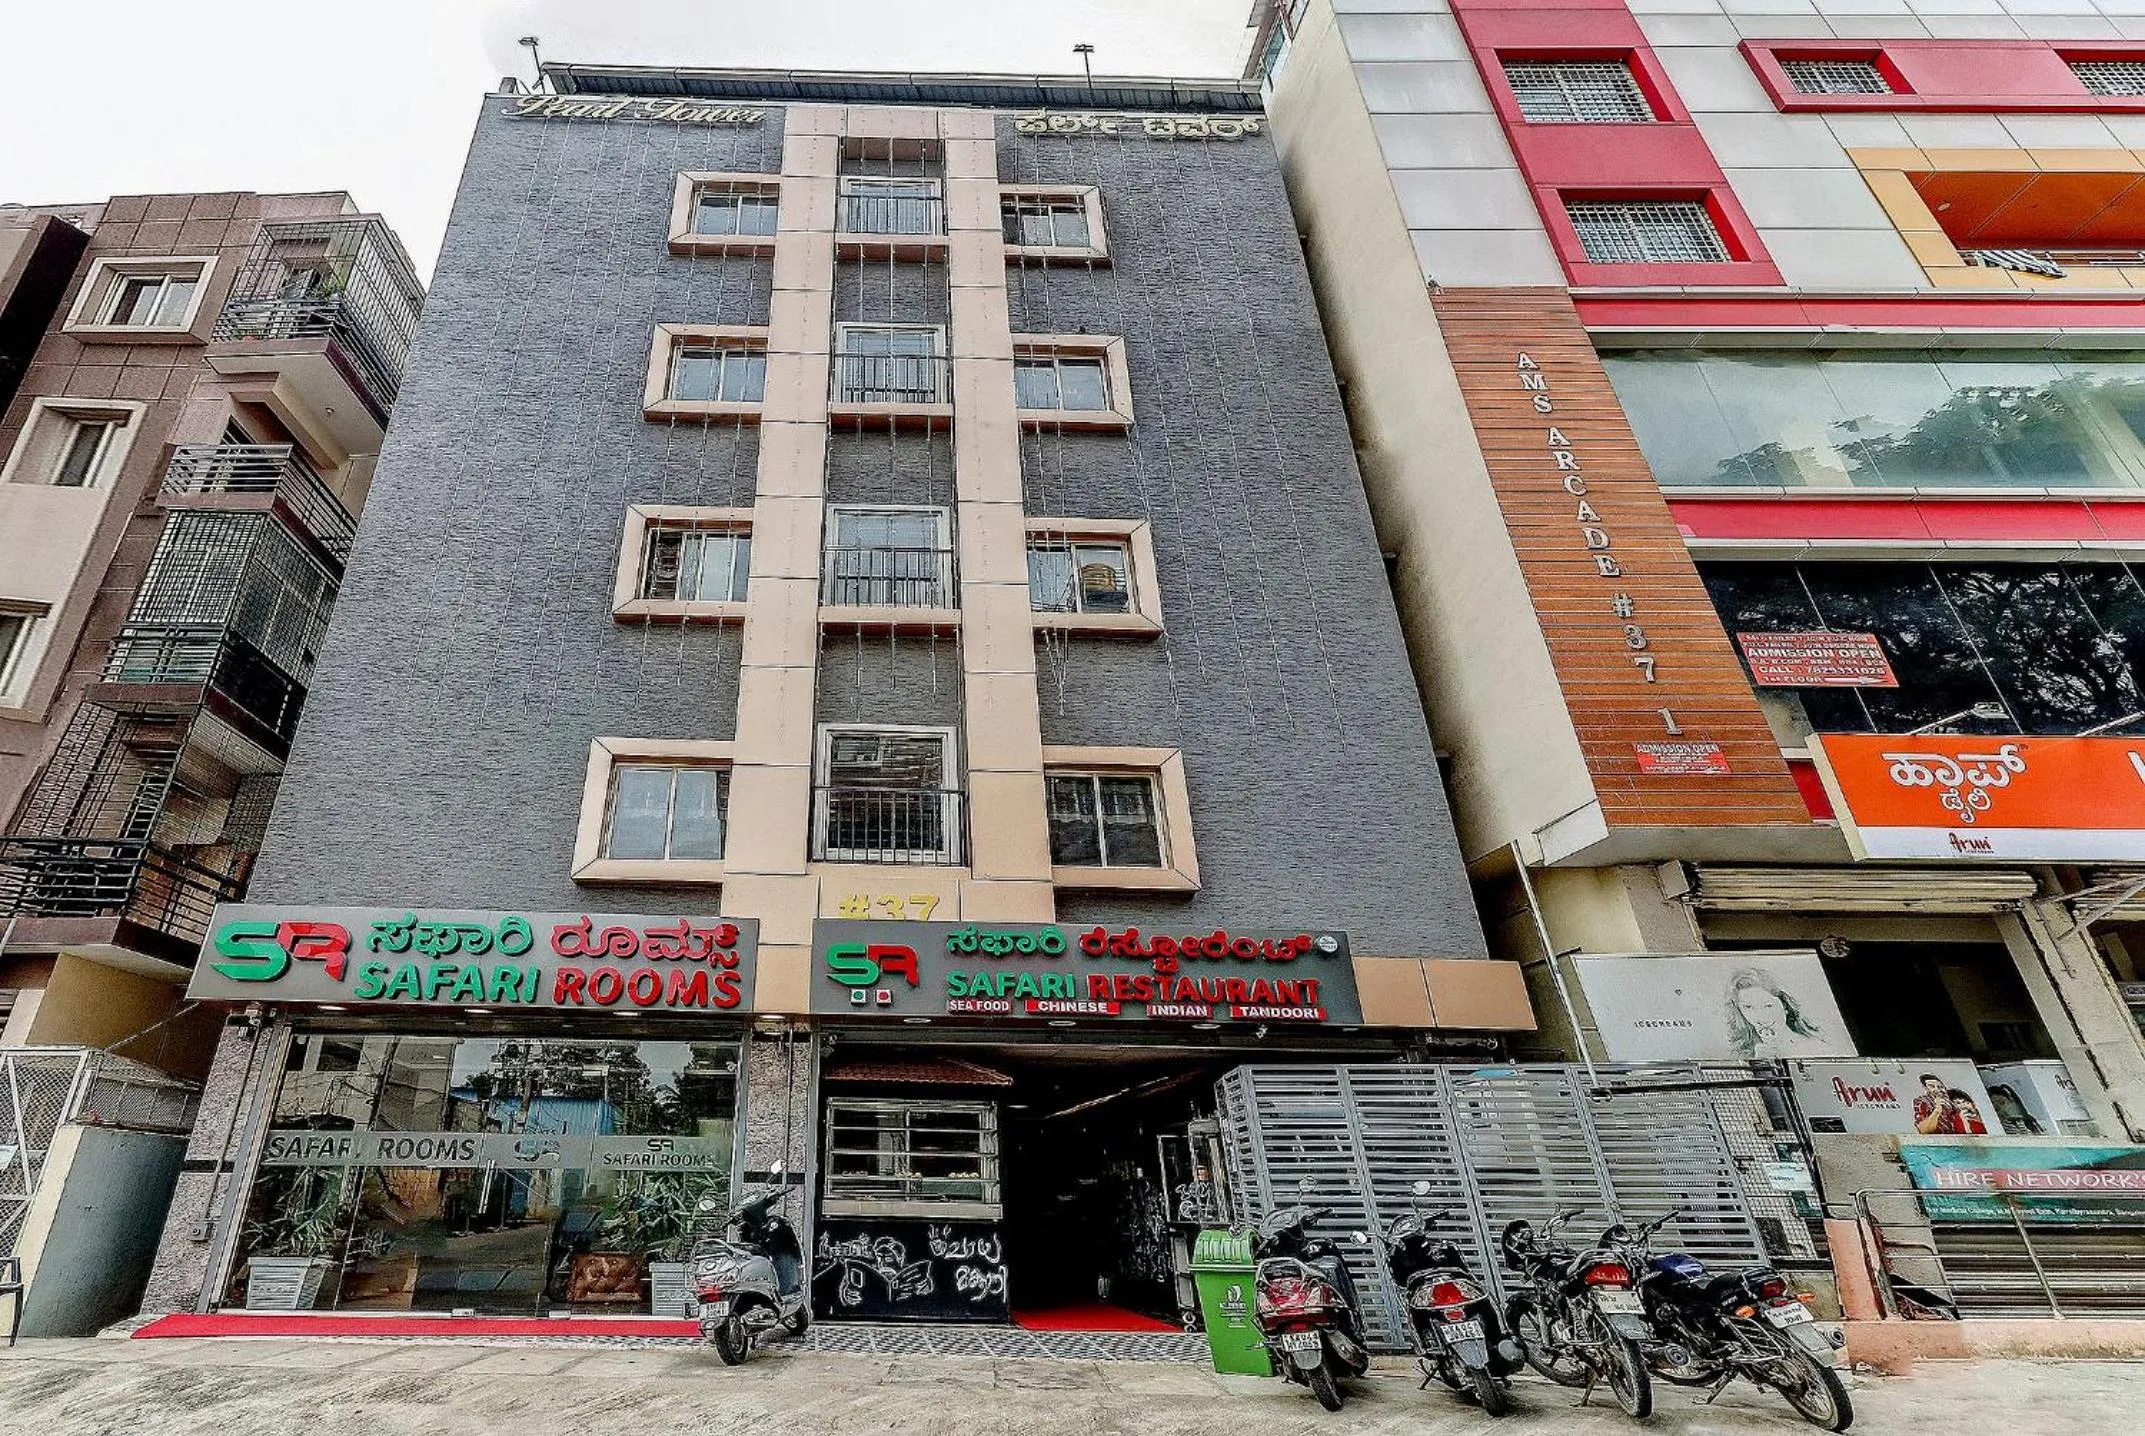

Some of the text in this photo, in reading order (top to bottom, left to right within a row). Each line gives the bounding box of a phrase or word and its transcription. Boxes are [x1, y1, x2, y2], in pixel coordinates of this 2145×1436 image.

[1517, 351, 1553, 414] AMS
[1547, 426, 1620, 577] ARCADE
[1748, 648, 1881, 659] ADMISSION OPEN
[354, 962, 742, 1008] SAFARI ROOMS
[946, 969, 1321, 1006] SAFARI RESTAURANT
[950, 999, 1010, 1011] SEA FOOD
[1038, 1000, 1108, 1012] CHINESE
[1150, 1004, 1208, 1017] INDIAN
[1239, 1006, 1319, 1019] TANDOORI
[376, 1137, 476, 1162] ROOMS
[603, 1153, 656, 1166] SAFARI
[1935, 1171, 1997, 1187] HIRE
